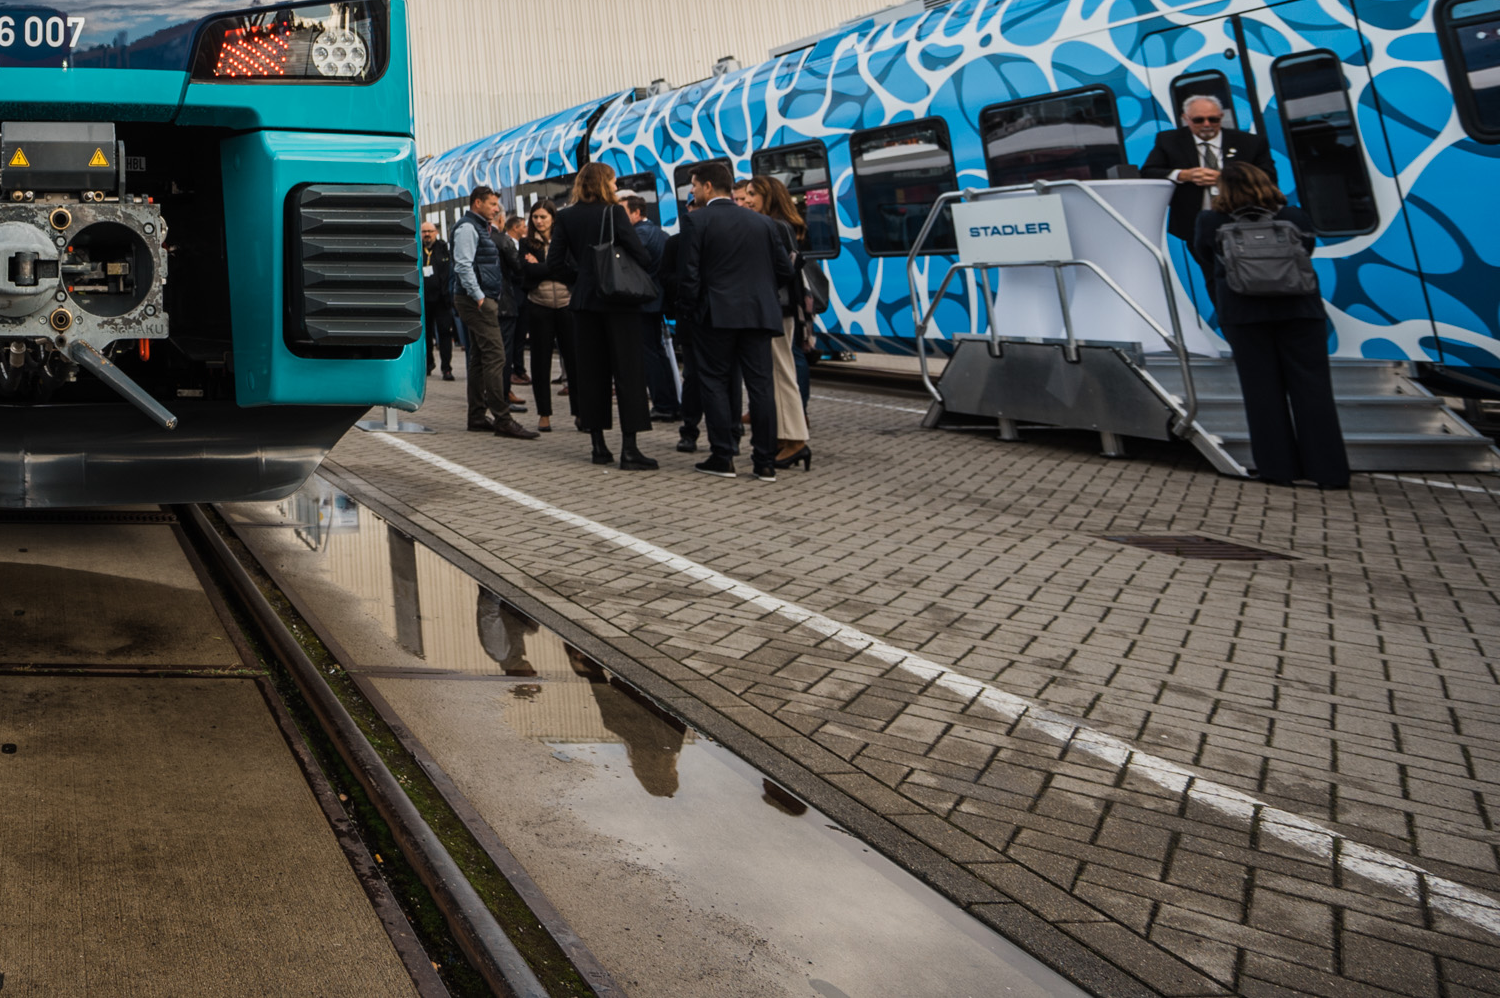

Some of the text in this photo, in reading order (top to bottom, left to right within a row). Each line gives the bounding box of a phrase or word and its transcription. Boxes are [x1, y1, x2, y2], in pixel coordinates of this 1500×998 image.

[24, 16, 85, 48] 007
[126, 157, 145, 170] HBL
[969, 222, 1051, 238] STADLER
